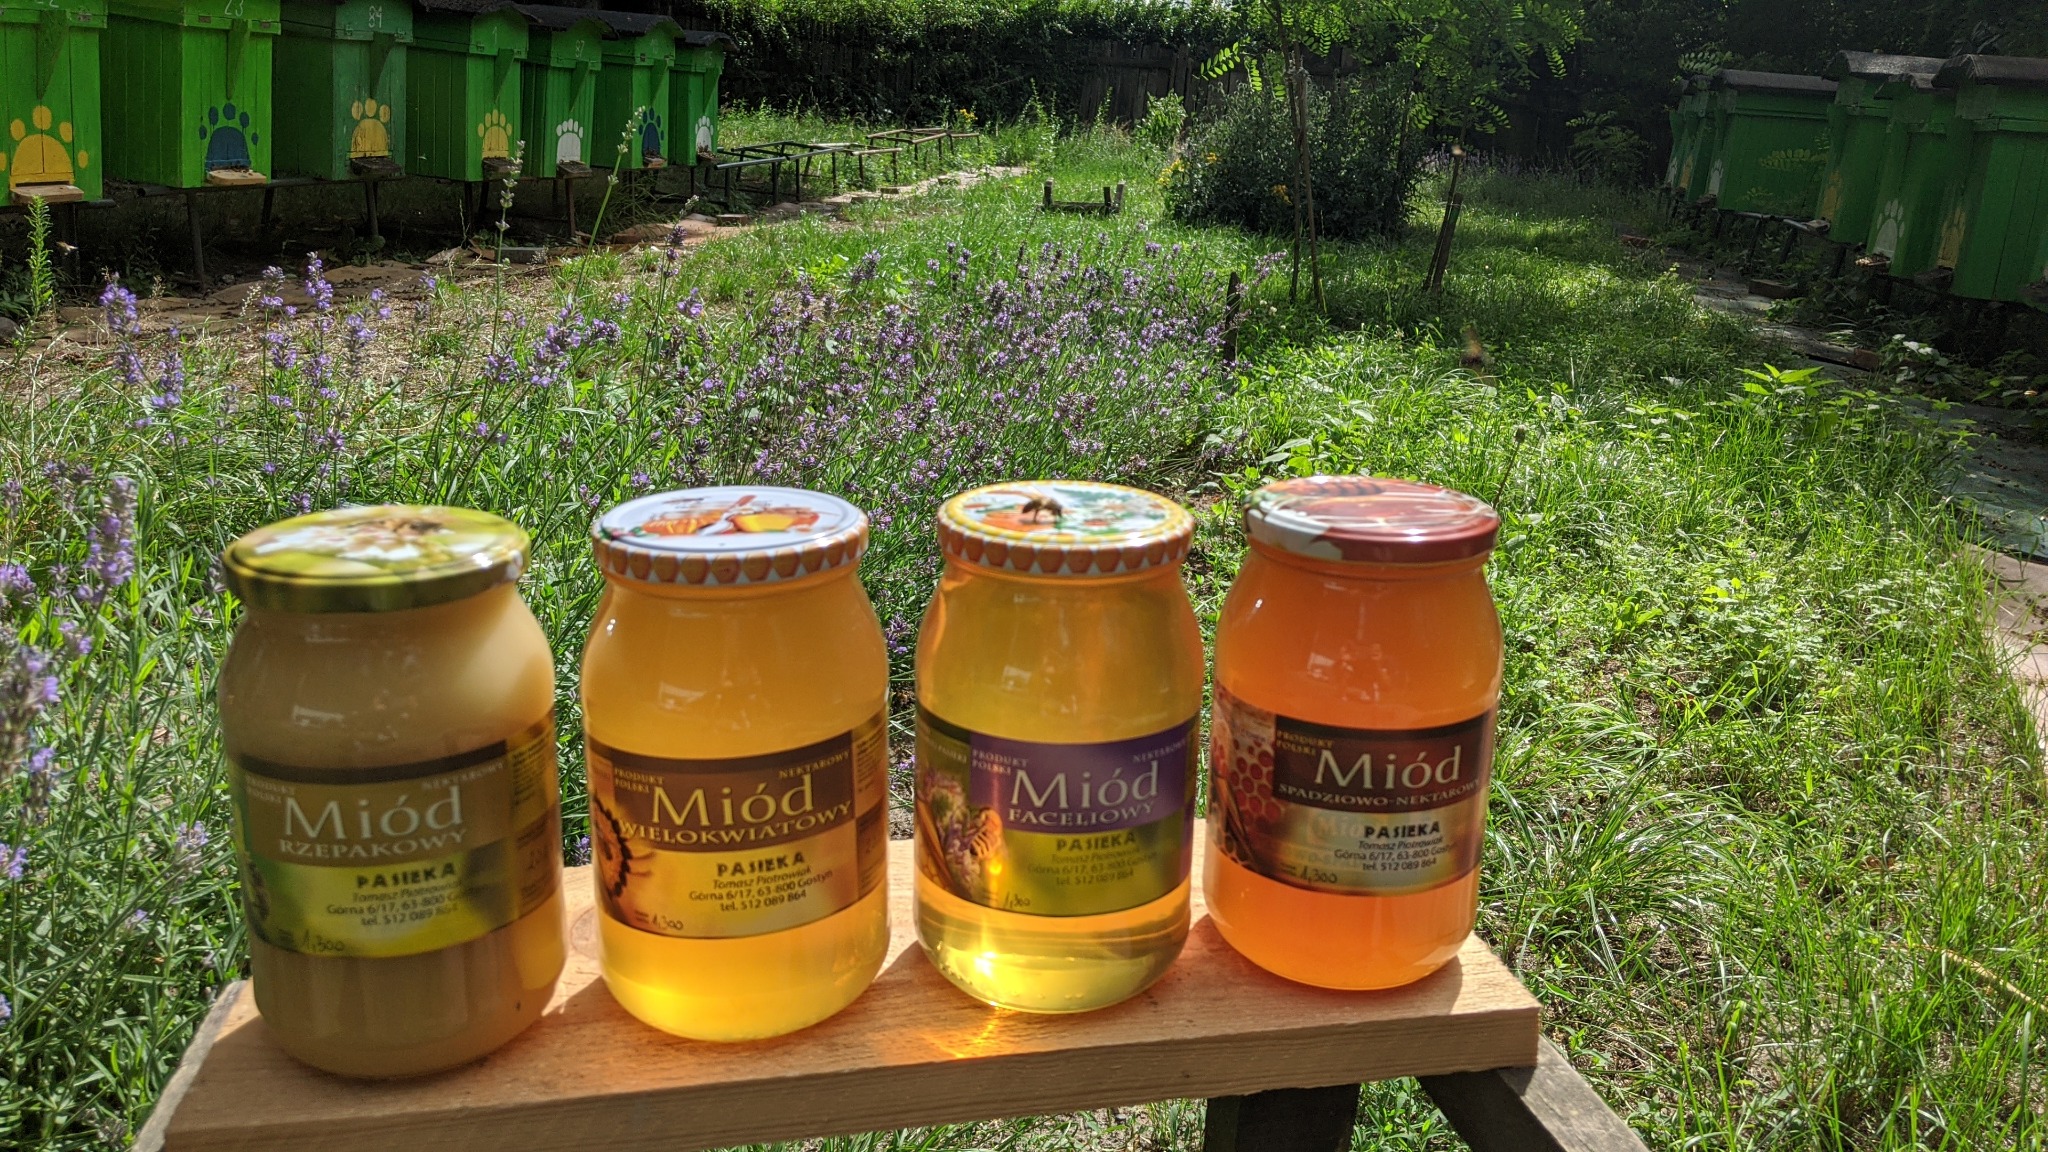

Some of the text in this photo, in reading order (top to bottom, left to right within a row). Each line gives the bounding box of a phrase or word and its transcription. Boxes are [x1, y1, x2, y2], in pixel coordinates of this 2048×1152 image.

[367, 5, 382, 28] 84
[1276, 729, 1335, 749] PRODUKT
[972, 748, 1029, 768] PRODUKT
[1314, 744, 1462, 790] Miód
[614, 766, 665, 785] PRODUKT
[614, 777, 649, 794] POLSKI
[1010, 759, 1159, 810] Miód
[651, 772, 814, 827] Miód
[284, 783, 464, 840] Miód
[617, 799, 851, 845] WIELOKWIATOWY
[1007, 800, 1155, 827] FACELIOWY
[1364, 820, 1441, 839] PASIEKA
[279, 829, 467, 859] RZEPAKOWY
[1056, 831, 1136, 852] PASIEKA
[1358, 839, 1396, 851] Tomasz
[355, 861, 456, 888] PASIEKA
[716, 851, 806, 877] PASIEKA
[1363, 862, 1378, 871] tel.
[1380, 862, 1400, 871] 512
[1401, 859, 1419, 871] 089
[713, 877, 755, 890] Tomasz
[726, 888, 756, 900] 6/17,
[720, 888, 807, 912] tel. 512 089 864
[383, 912, 406, 924] 512
